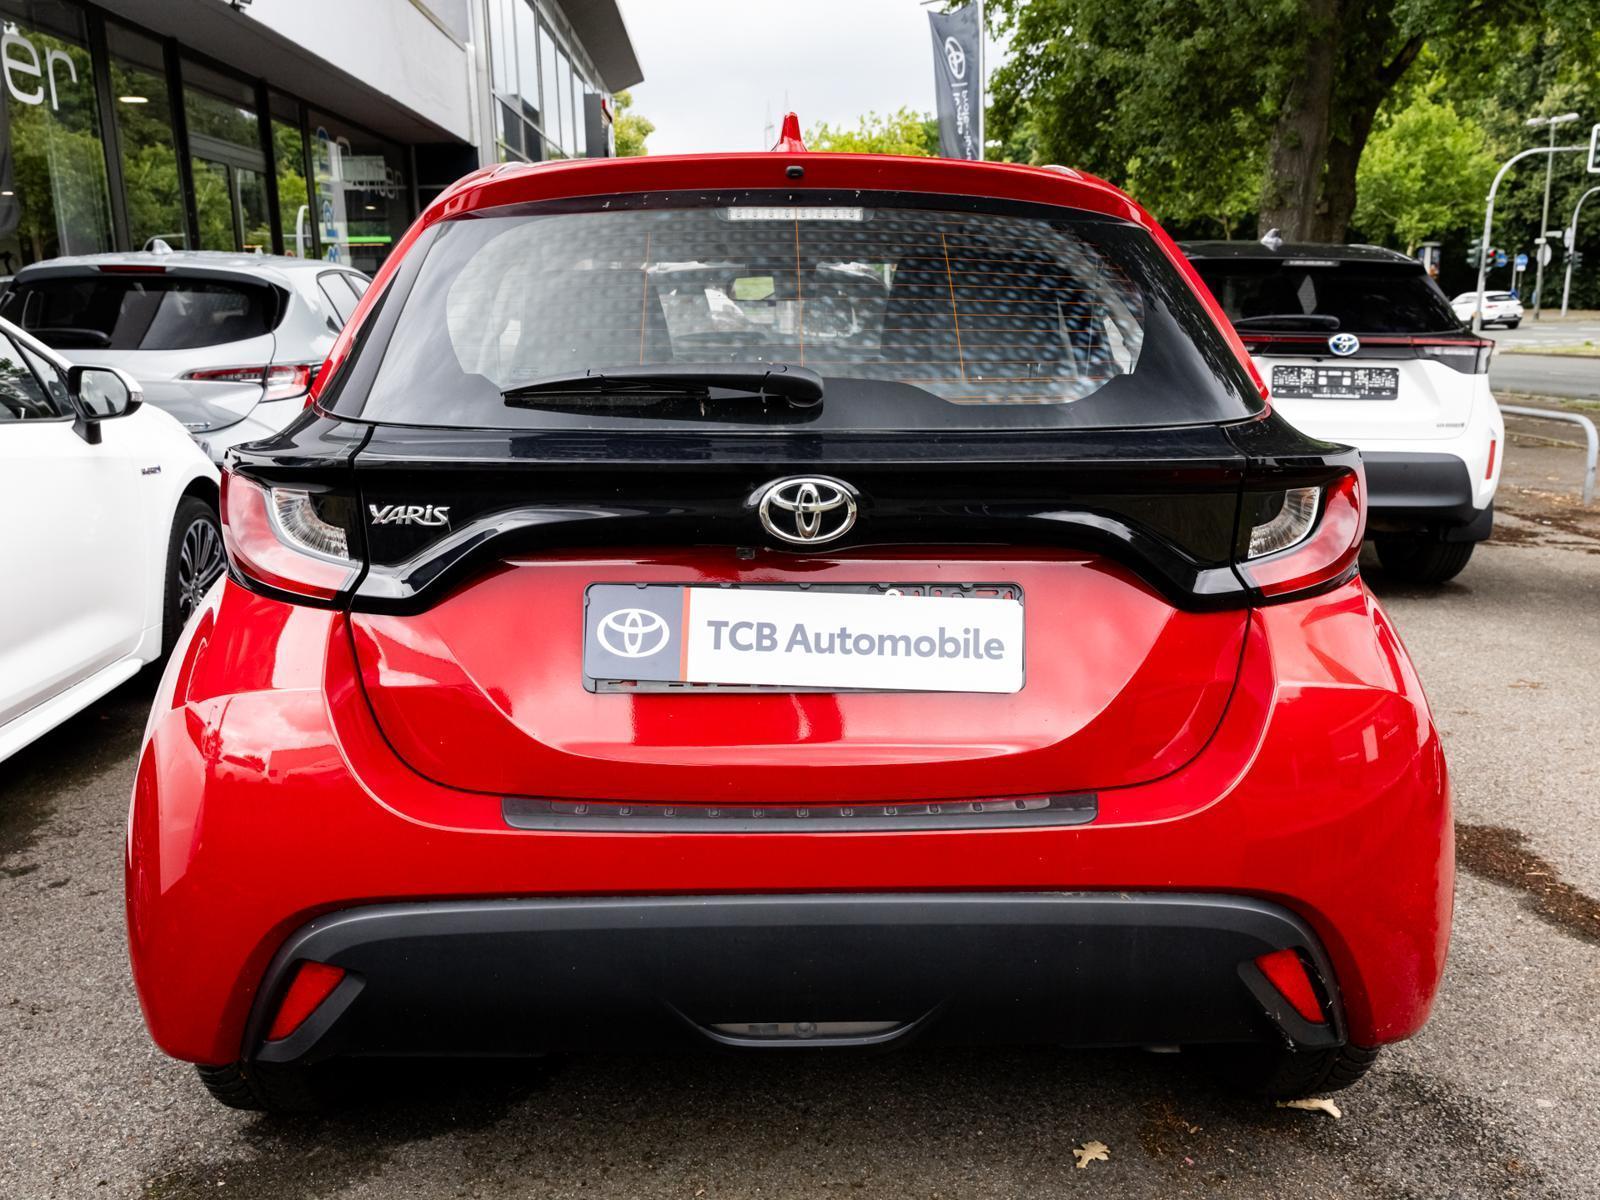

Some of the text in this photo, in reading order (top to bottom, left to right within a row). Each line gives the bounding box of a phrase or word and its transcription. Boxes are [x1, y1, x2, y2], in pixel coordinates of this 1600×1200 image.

[368, 504, 451, 526] YARIS
[707, 620, 1005, 660] TCB Automobile
